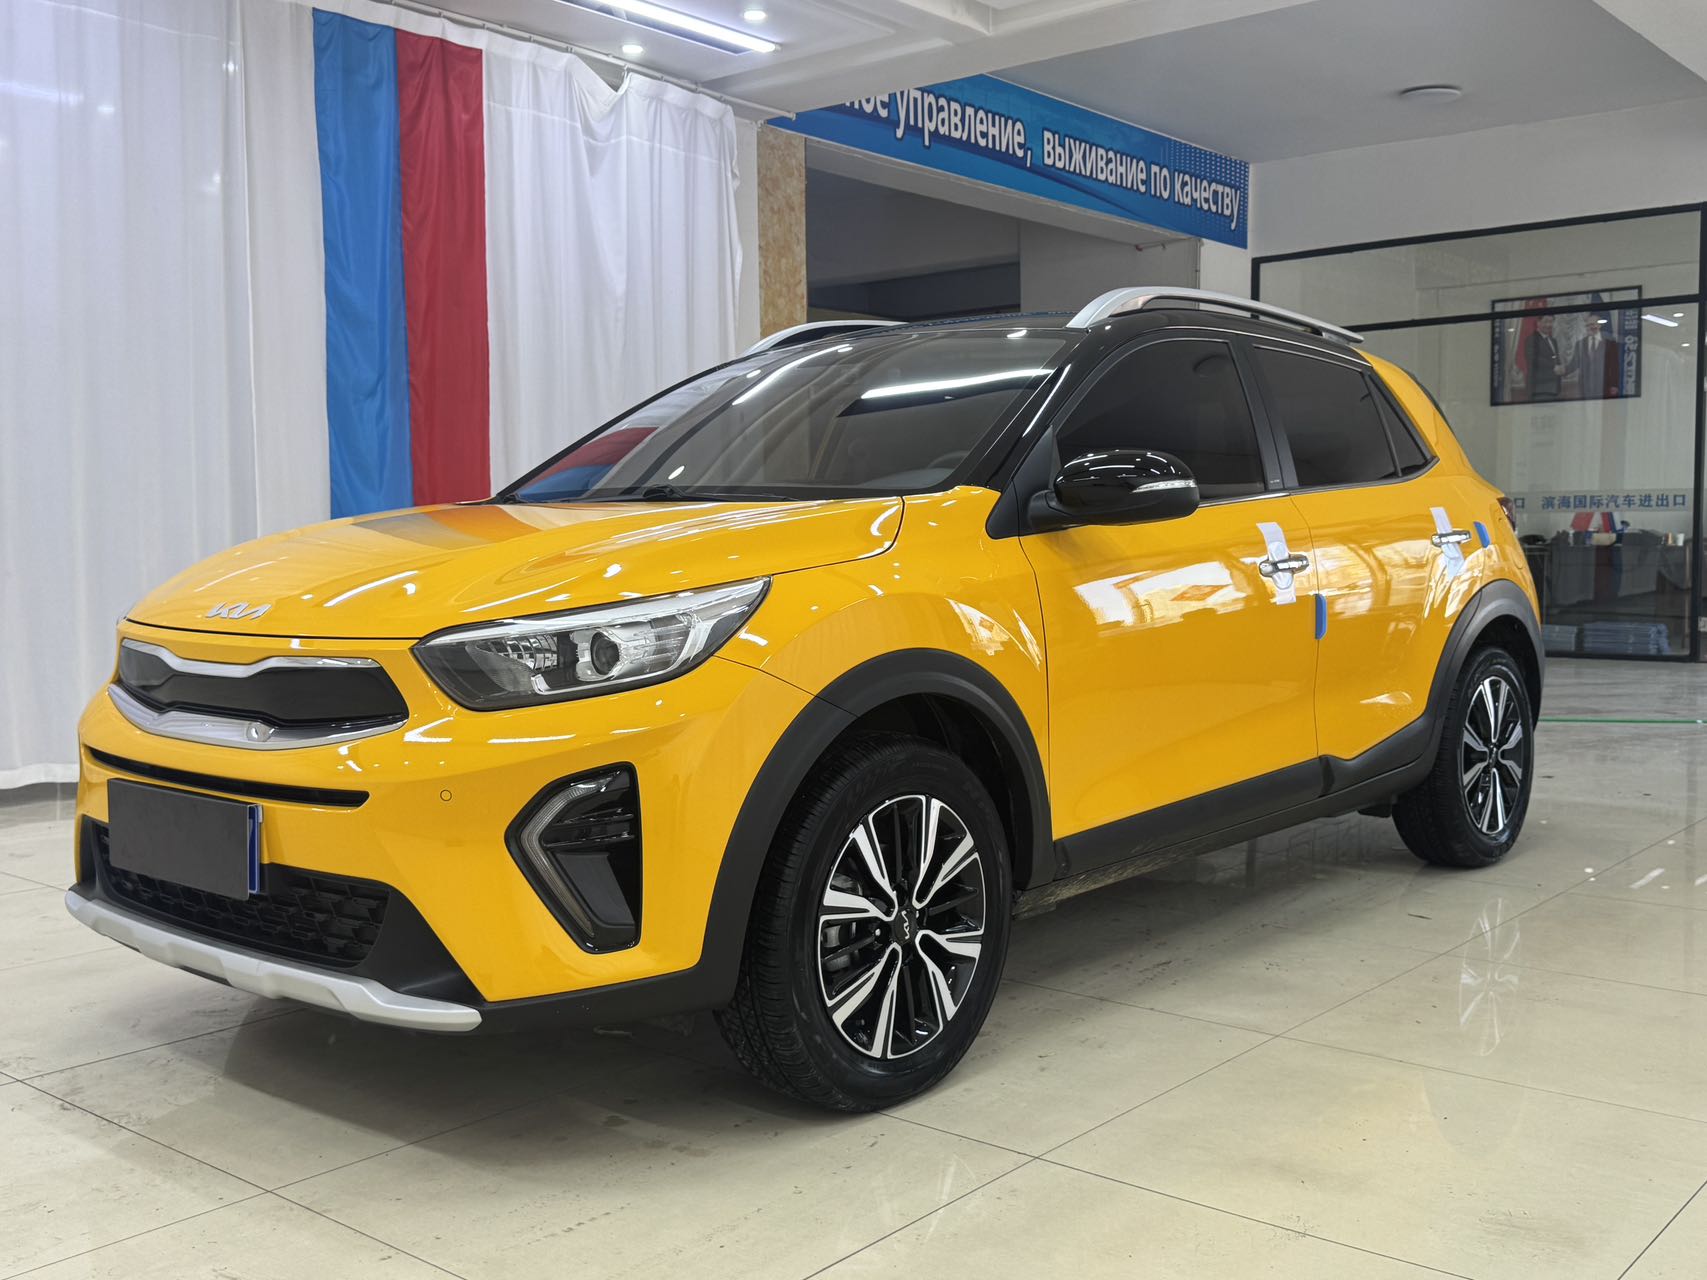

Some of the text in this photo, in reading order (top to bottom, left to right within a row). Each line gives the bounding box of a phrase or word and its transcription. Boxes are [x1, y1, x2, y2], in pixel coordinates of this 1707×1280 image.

[896, 88, 1032, 167] управление,
[1043, 130, 1147, 193] выживание
[1150, 164, 1170, 200] по
[1174, 171, 1240, 231] качеству
[1541, 493, 1687, 510] 滨海国际汽车进出口
